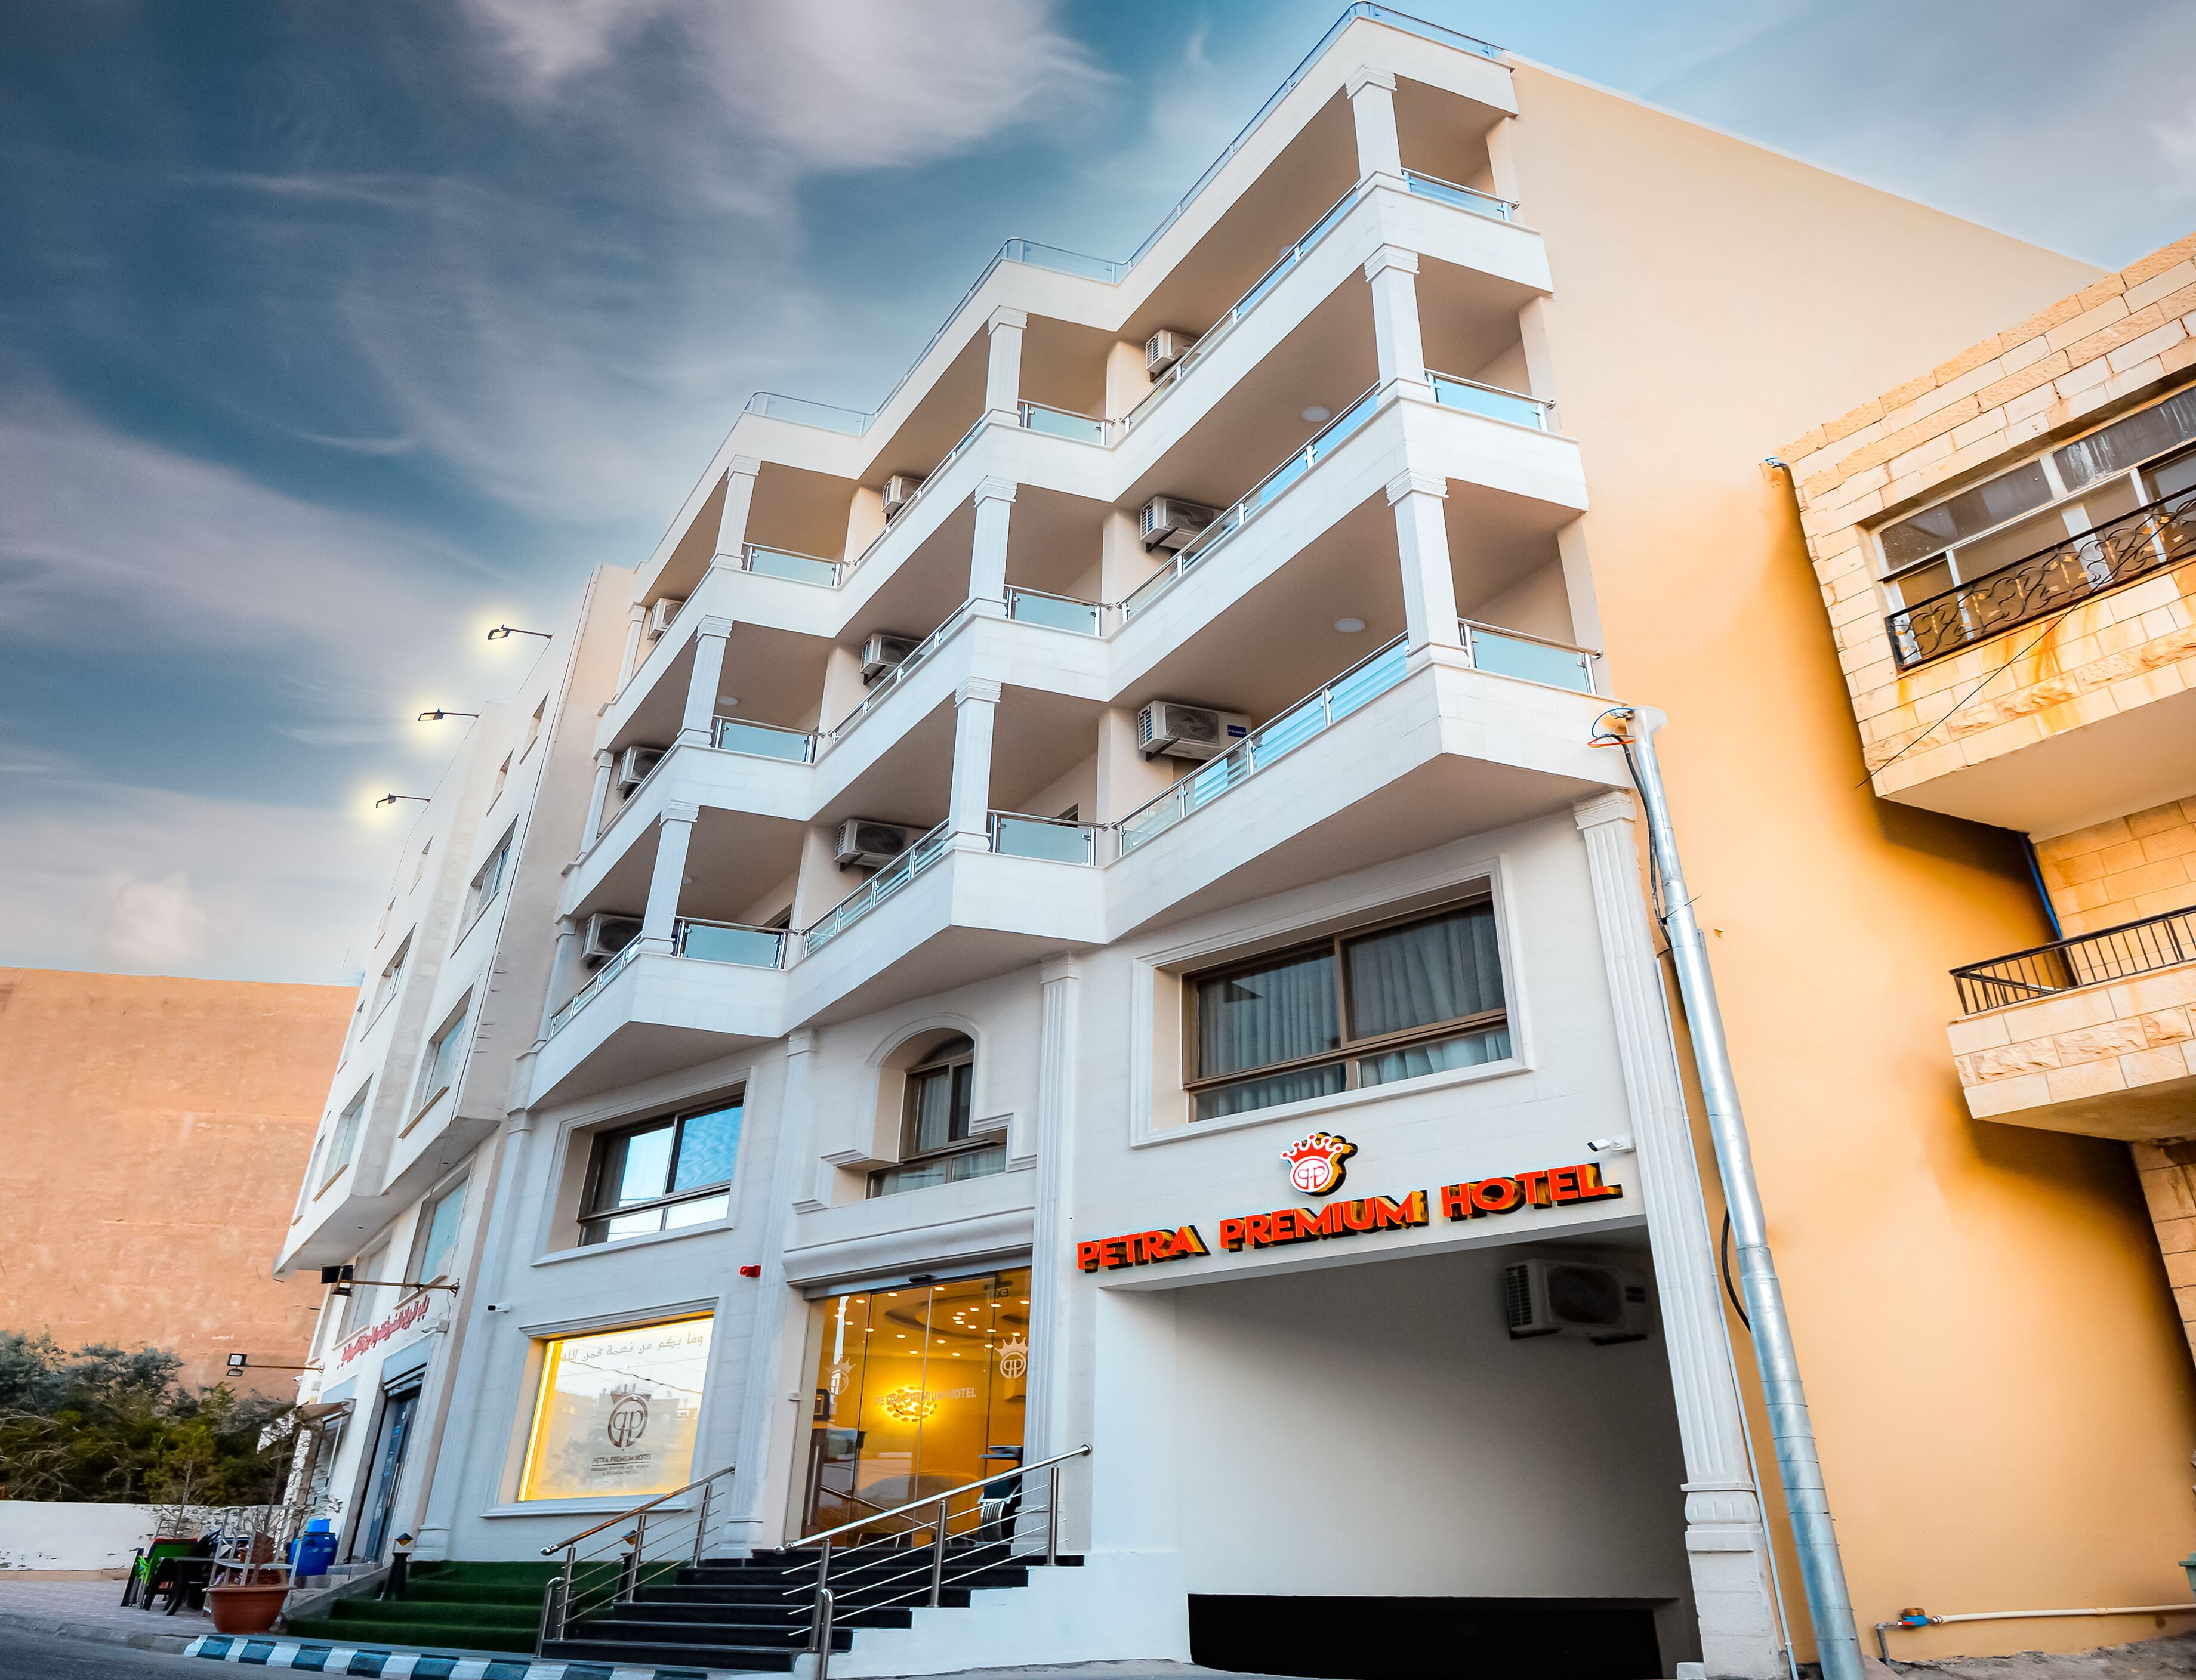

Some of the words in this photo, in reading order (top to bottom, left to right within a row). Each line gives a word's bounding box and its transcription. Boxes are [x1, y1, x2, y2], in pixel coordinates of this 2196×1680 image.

[1077, 1226, 1196, 1270] PETRA
[1220, 1191, 1417, 1249] PREMIUM
[1440, 1163, 1611, 1218] HOTEL
[657, 1336, 681, 1351] بكم
[687, 1332, 704, 1347] وما
[582, 1346, 602, 1362] فمن
[606, 1342, 633, 1356] نعمة
[948, 1386, 976, 1400] HOTEL
